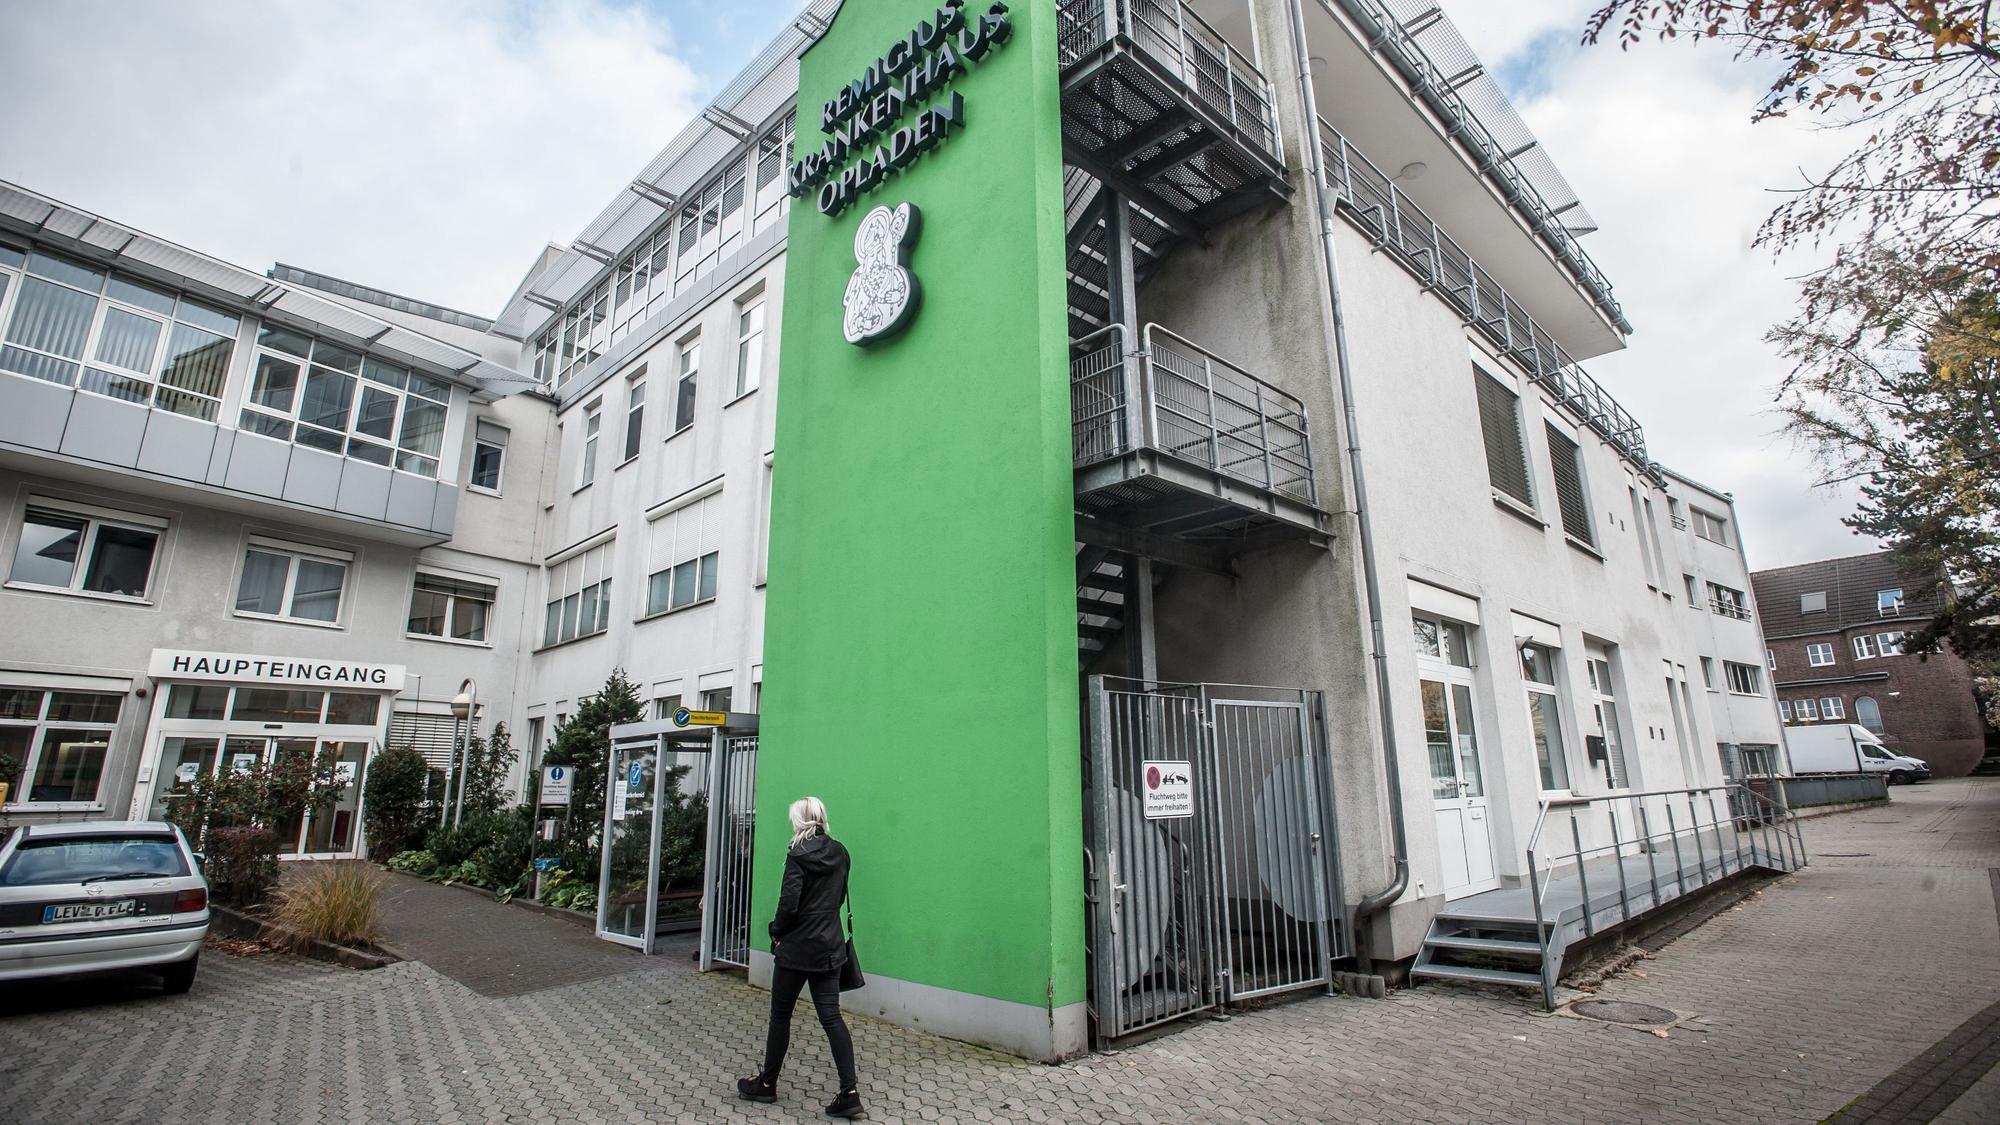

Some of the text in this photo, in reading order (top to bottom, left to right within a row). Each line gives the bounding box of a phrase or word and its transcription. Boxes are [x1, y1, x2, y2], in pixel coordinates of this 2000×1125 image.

[787, 1, 1011, 197] KRANKENHAUS
[820, 0, 964, 132] REMIGIUS
[816, 90, 964, 217] OPLADEN
[172, 655, 388, 684] HAUPTEINGANG
[1149, 793, 1176, 801] Fluchtweg
